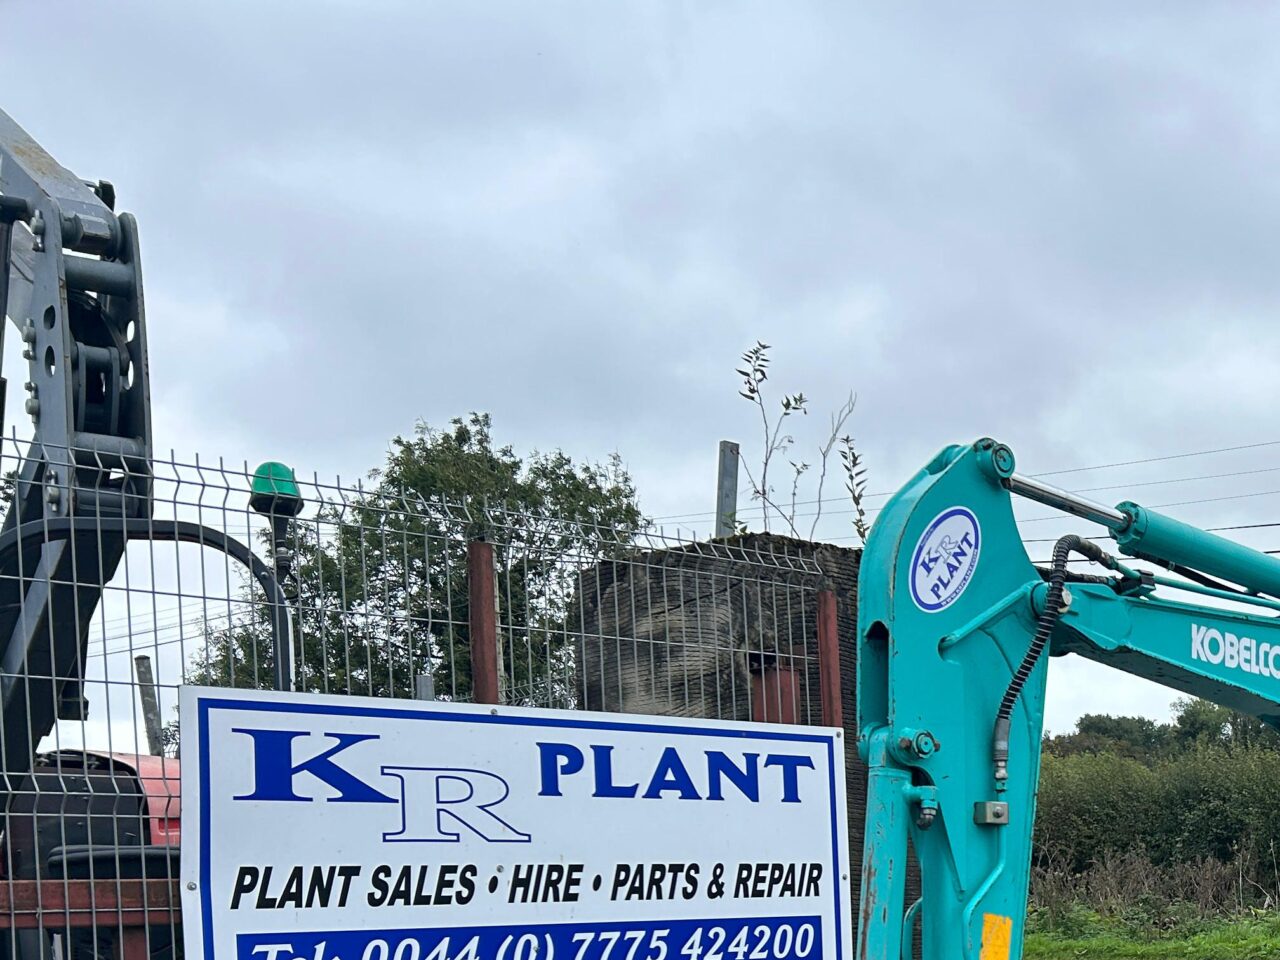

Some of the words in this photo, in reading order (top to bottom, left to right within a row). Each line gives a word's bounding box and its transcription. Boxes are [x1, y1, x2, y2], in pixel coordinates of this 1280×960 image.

[930, 531, 974, 600] PLANT
[231, 727, 532, 844] KR
[536, 741, 816, 804] PLANT
[230, 865, 361, 910] PLANT
[367, 864, 478, 907] SALES
[508, 864, 585, 904] HIRE
[610, 863, 700, 901] PARTS
[707, 862, 725, 900] &
[733, 862, 823, 899] REPAIR
